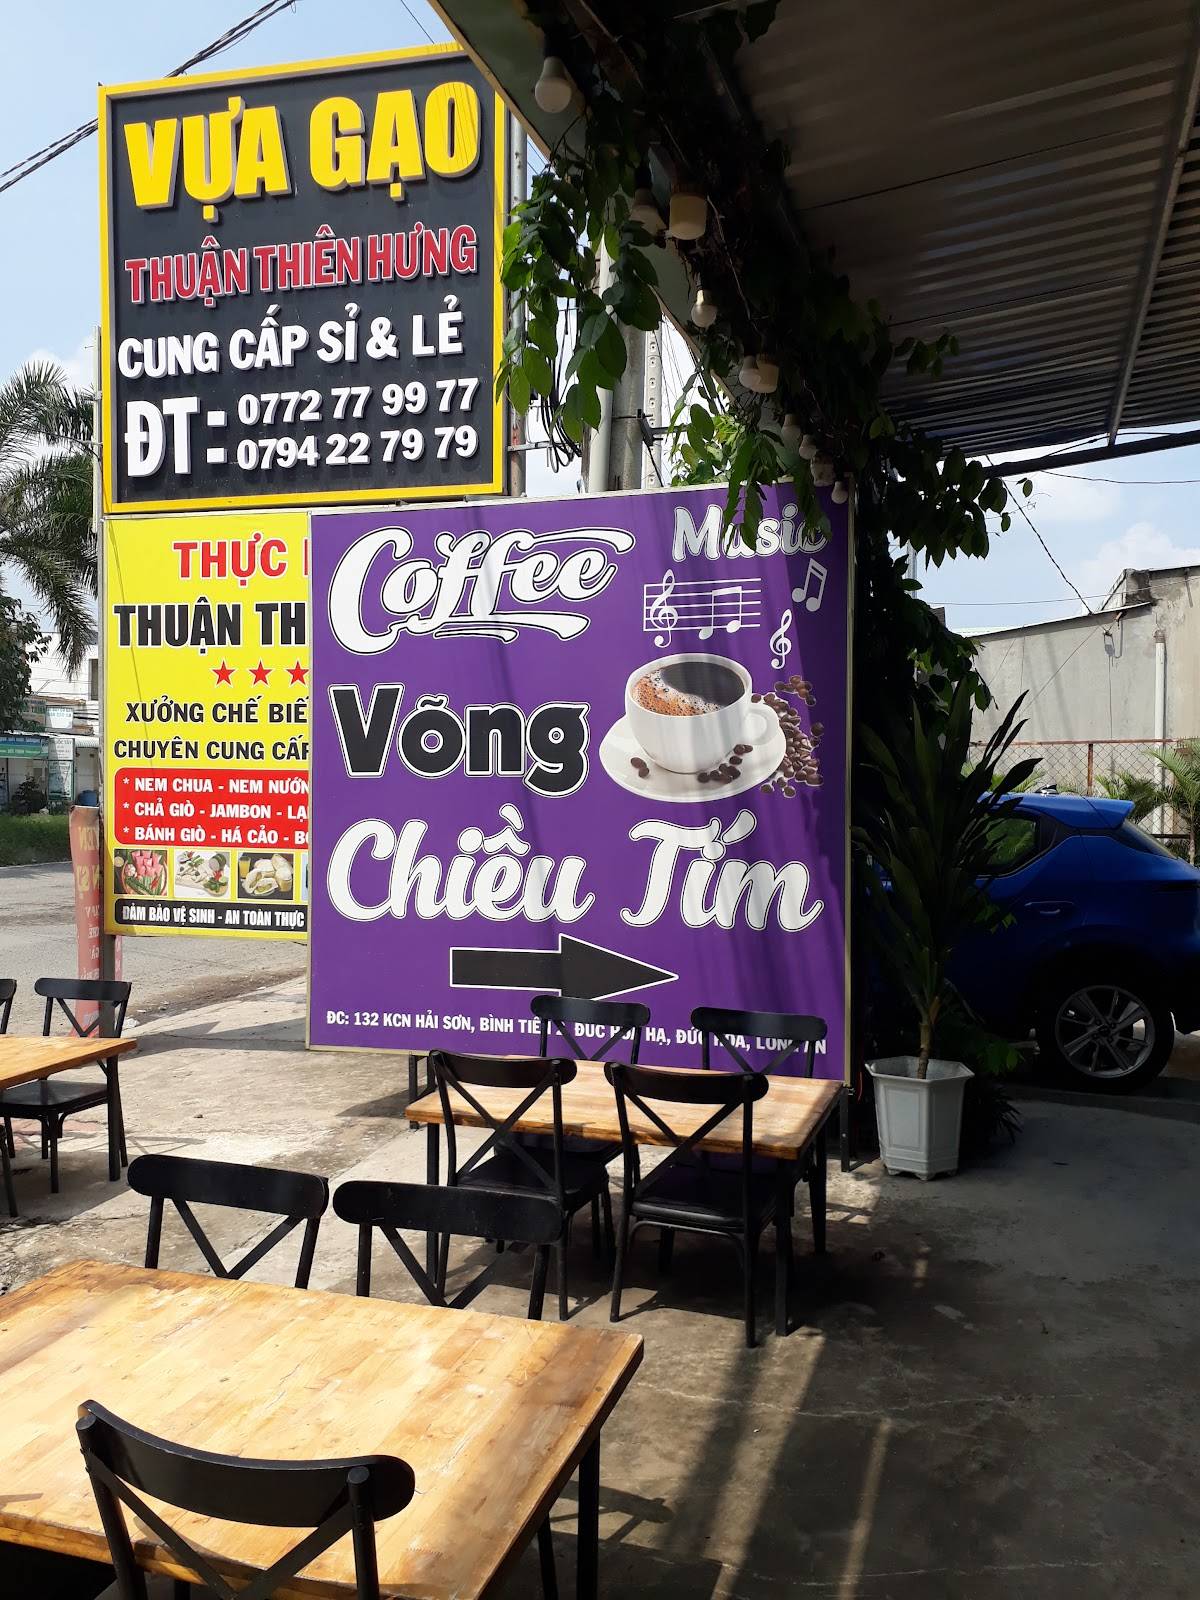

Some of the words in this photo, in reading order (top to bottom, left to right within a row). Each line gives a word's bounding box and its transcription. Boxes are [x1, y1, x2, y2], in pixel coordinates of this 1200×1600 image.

[124, 96, 293, 222] VỰA
[310, 81, 480, 202] GẠO
[124, 236, 247, 306] THUẬN
[253, 223, 360, 292] THIÊN
[367, 222, 478, 281] HƯNG
[118, 332, 220, 379] CUNG
[229, 304, 309, 370] CẤP
[316, 302, 360, 363] SỈ
[365, 316, 399, 360] &
[412, 295, 465, 357] LẺ
[237, 389, 323, 426] 0772
[331, 385, 373, 420] 77
[382, 380, 427, 417] 99
[436, 377, 479, 413] 77
[237, 434, 321, 470] 0794
[325, 431, 371, 466] 22
[380, 429, 425, 464] 79
[435, 424, 478, 461] 79
[173, 532, 287, 586] THỰC
[328, 526, 636, 655] Coffee
[114, 596, 241, 654] THUẬN
[126, 695, 204, 722] XƯỞNG
[212, 696, 262, 723] CHẾ
[114, 736, 199, 759] CHUYÊN
[206, 742, 265, 760] CUNG
[327, 683, 590, 797] Võng
[134, 777, 168, 792] NEM
[172, 778, 213, 793] CHUA
[229, 779, 263, 794] NEM
[134, 798, 164, 816] CHẢ
[169, 800, 195, 817] GIÒ
[210, 804, 271, 819] JAMBON
[134, 824, 175, 841] BÁNH
[180, 825, 206, 842] GIÒ
[221, 826, 242, 843] HÁ
[247, 825, 279, 844] CẢO
[326, 803, 595, 922] Chiều
[620, 808, 824, 932] Tím
[149, 903, 171, 922] BẢO
[173, 905, 186, 925] VỆ
[189, 908, 215, 924] SINH
[225, 909, 239, 925] AN
[243, 909, 272, 926] TOÀN
[274, 909, 305, 929] THỰC
[326, 1010, 349, 1025] ĐC:
[354, 1011, 379, 1026] 132
[383, 1013, 412, 1027] KCN
[415, 1009, 439, 1028] HẢI
[442, 1013, 476, 1034] SƠN,
[480, 1014, 513, 1033] BÌNH
